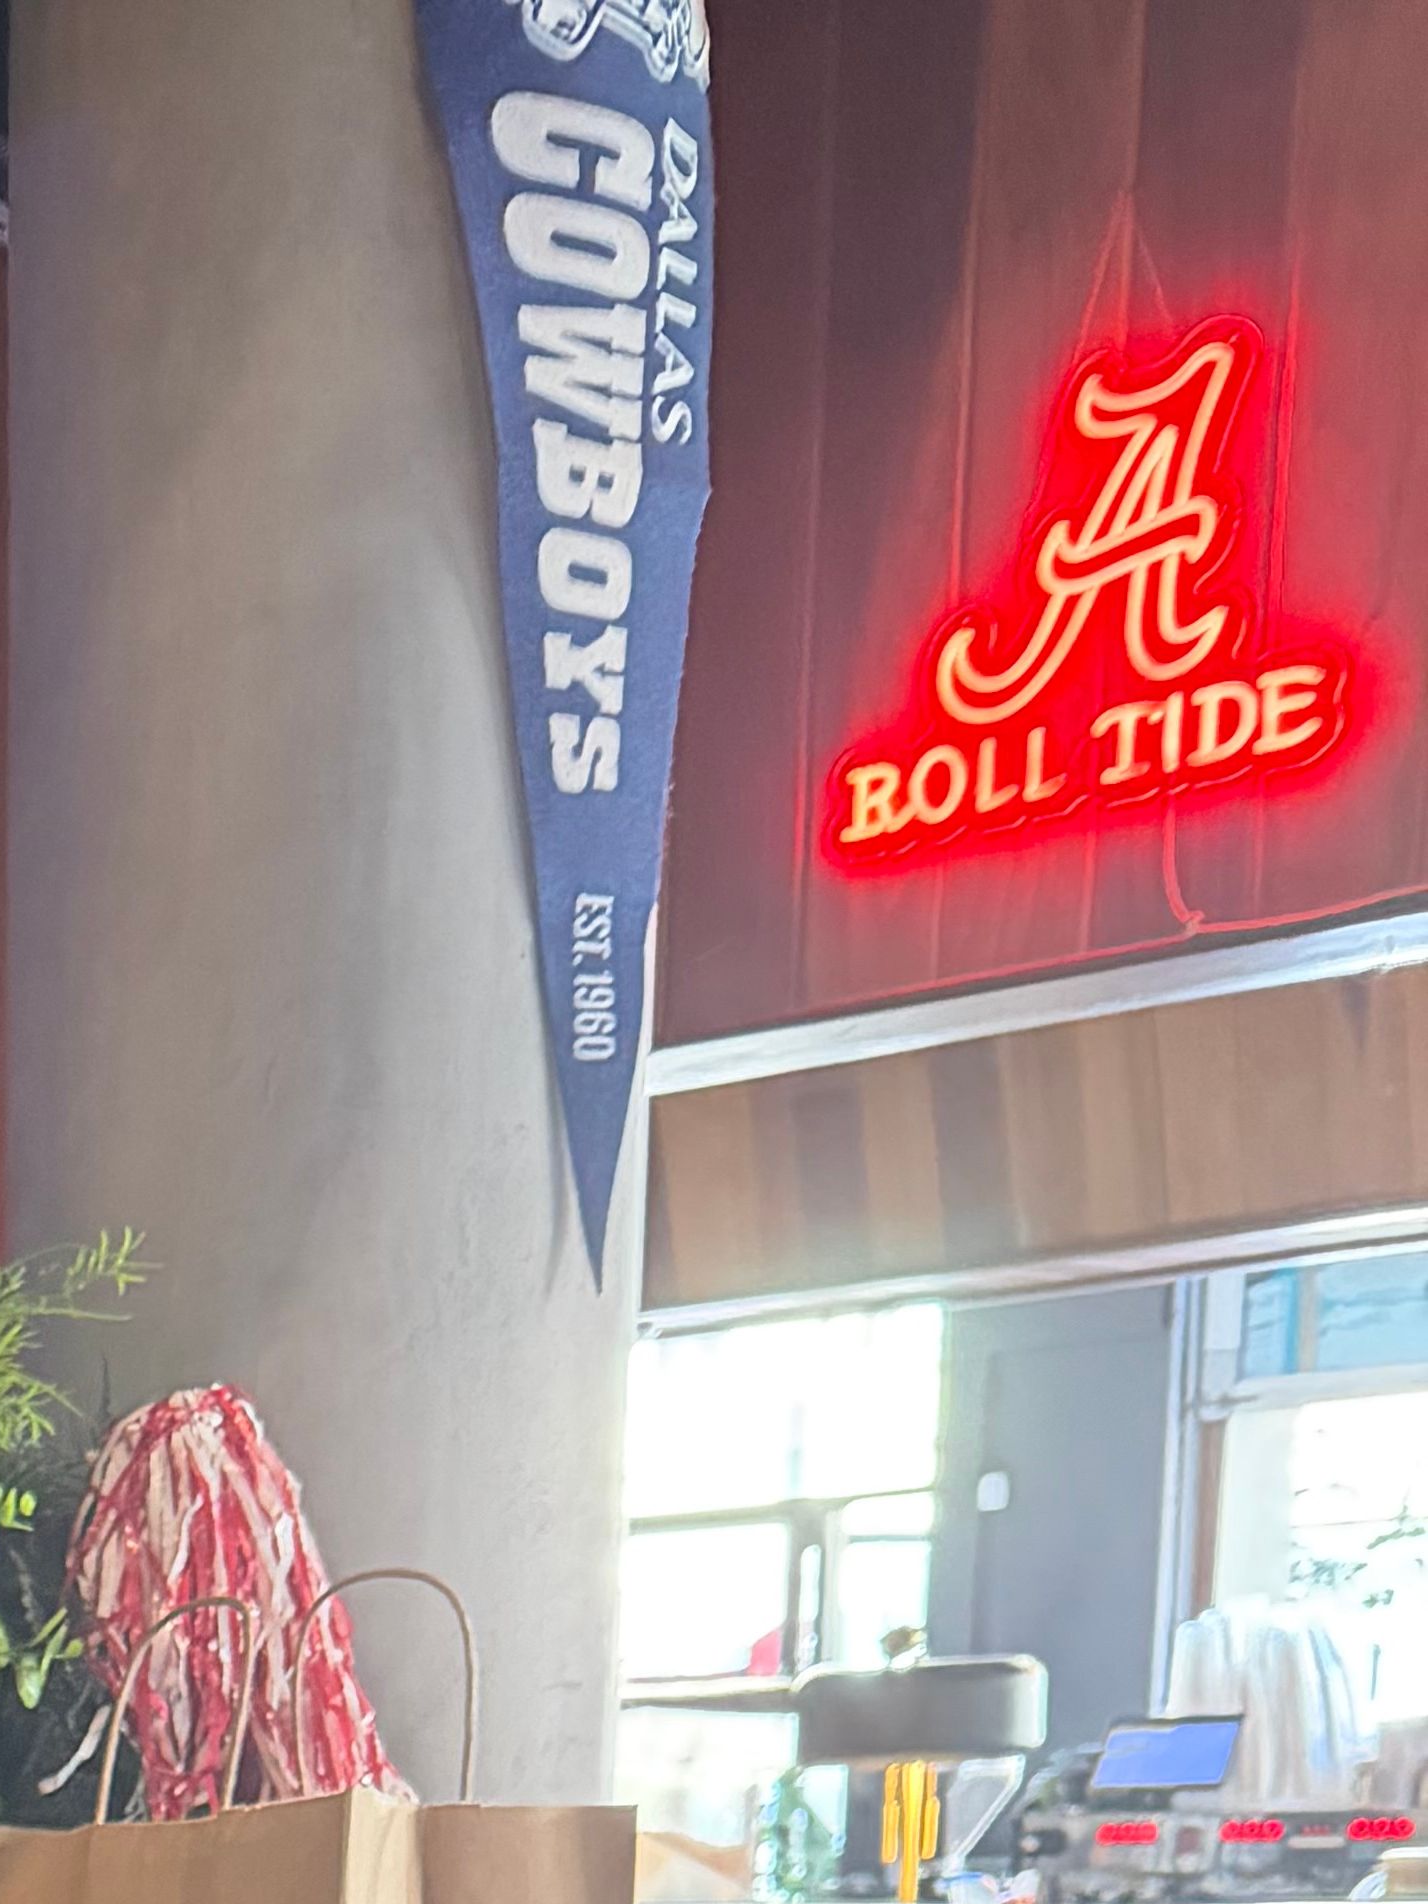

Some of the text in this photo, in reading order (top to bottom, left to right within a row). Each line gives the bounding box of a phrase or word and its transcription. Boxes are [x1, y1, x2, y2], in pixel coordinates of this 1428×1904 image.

[649, 115, 698, 447] DALLAS
[489, 89, 655, 797] COWBOYS
[839, 664, 1328, 844] ROLL TIDE
[572, 892, 617, 1062] EST. 1960
